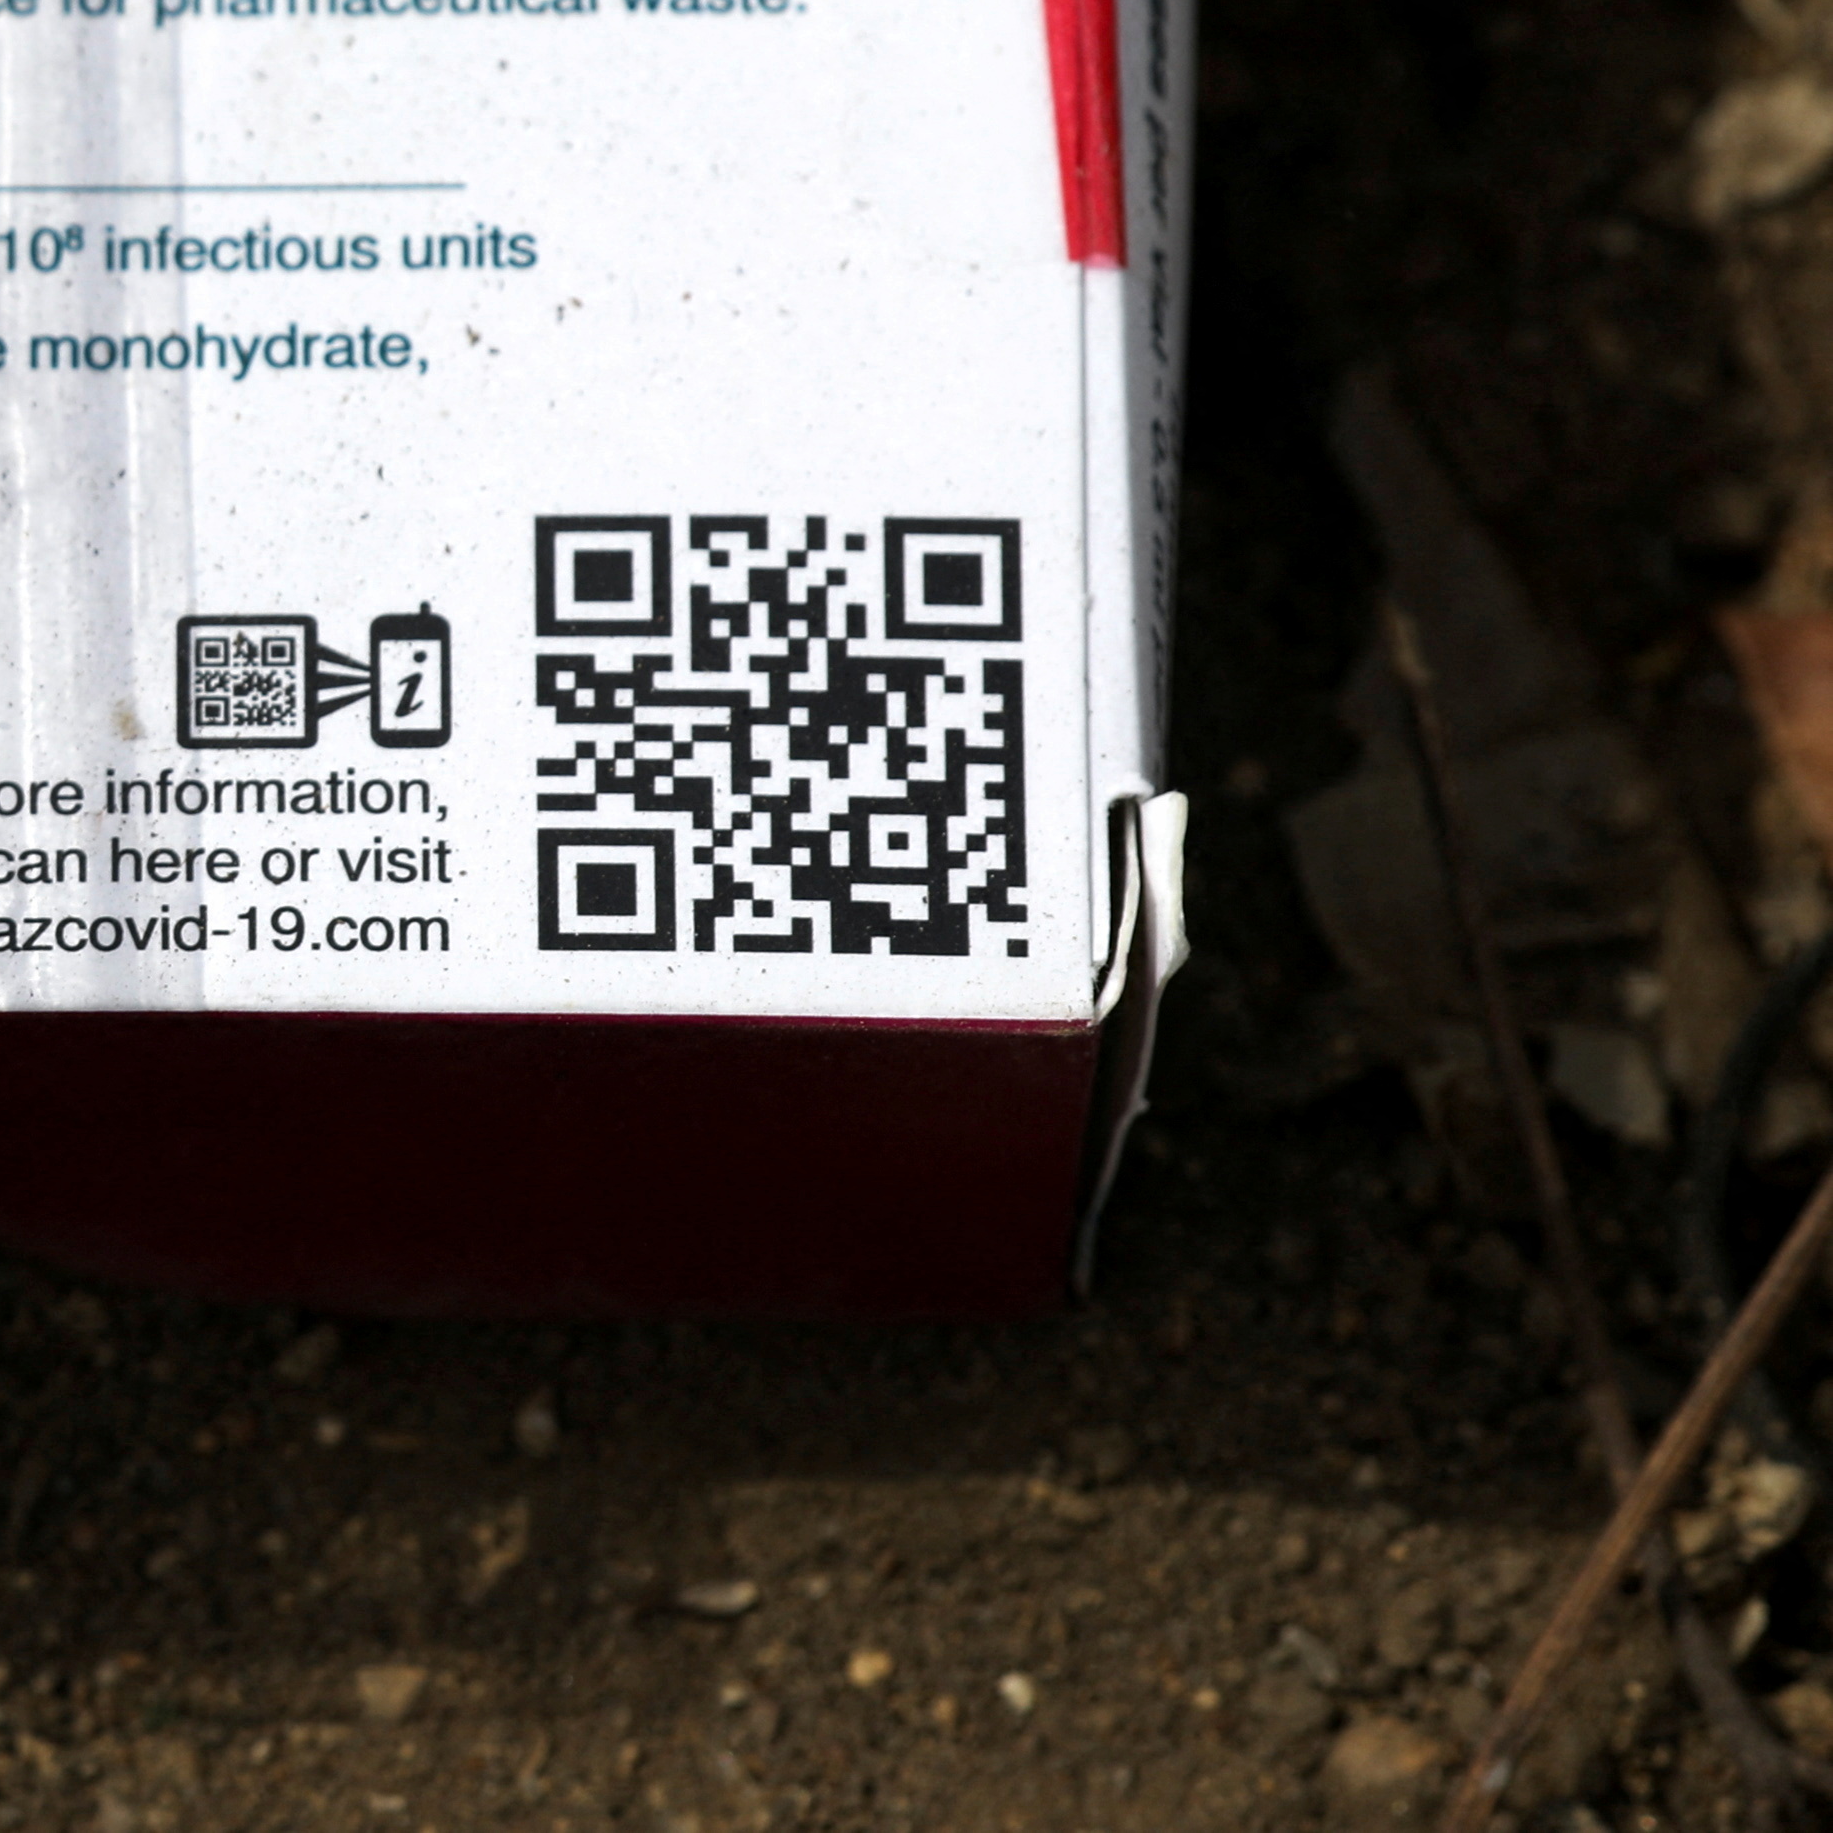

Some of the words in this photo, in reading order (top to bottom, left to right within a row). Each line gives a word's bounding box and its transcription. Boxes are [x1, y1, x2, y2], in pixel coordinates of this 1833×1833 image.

[103, 226, 379, 272] infectious
[401, 226, 539, 270] units
[30, 326, 430, 381] monohydrate,
[105, 770, 450, 824] information,
[111, 837, 242, 884] here
[260, 850, 322, 884] or
[337, 838, 453, 884] visit
